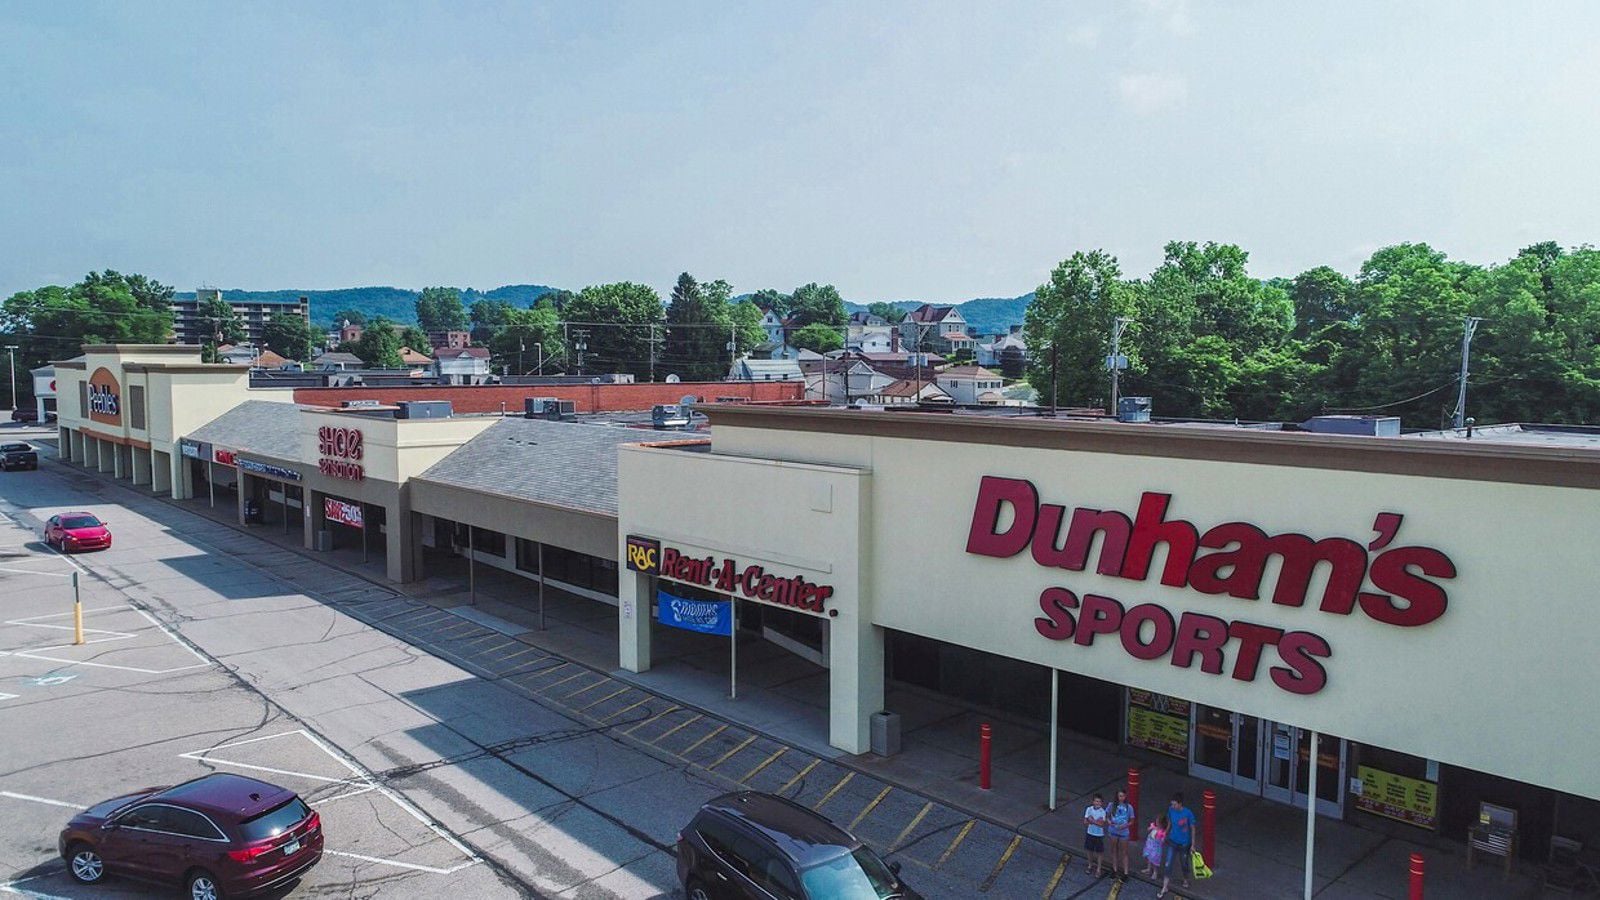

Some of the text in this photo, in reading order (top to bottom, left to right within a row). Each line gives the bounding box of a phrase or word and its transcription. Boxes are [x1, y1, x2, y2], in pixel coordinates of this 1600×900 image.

[87, 384, 117, 415] Peebles
[628, 544, 656, 571] RAC
[966, 475, 1457, 627] Dunham's
[1034, 586, 1332, 695] SPORTS
